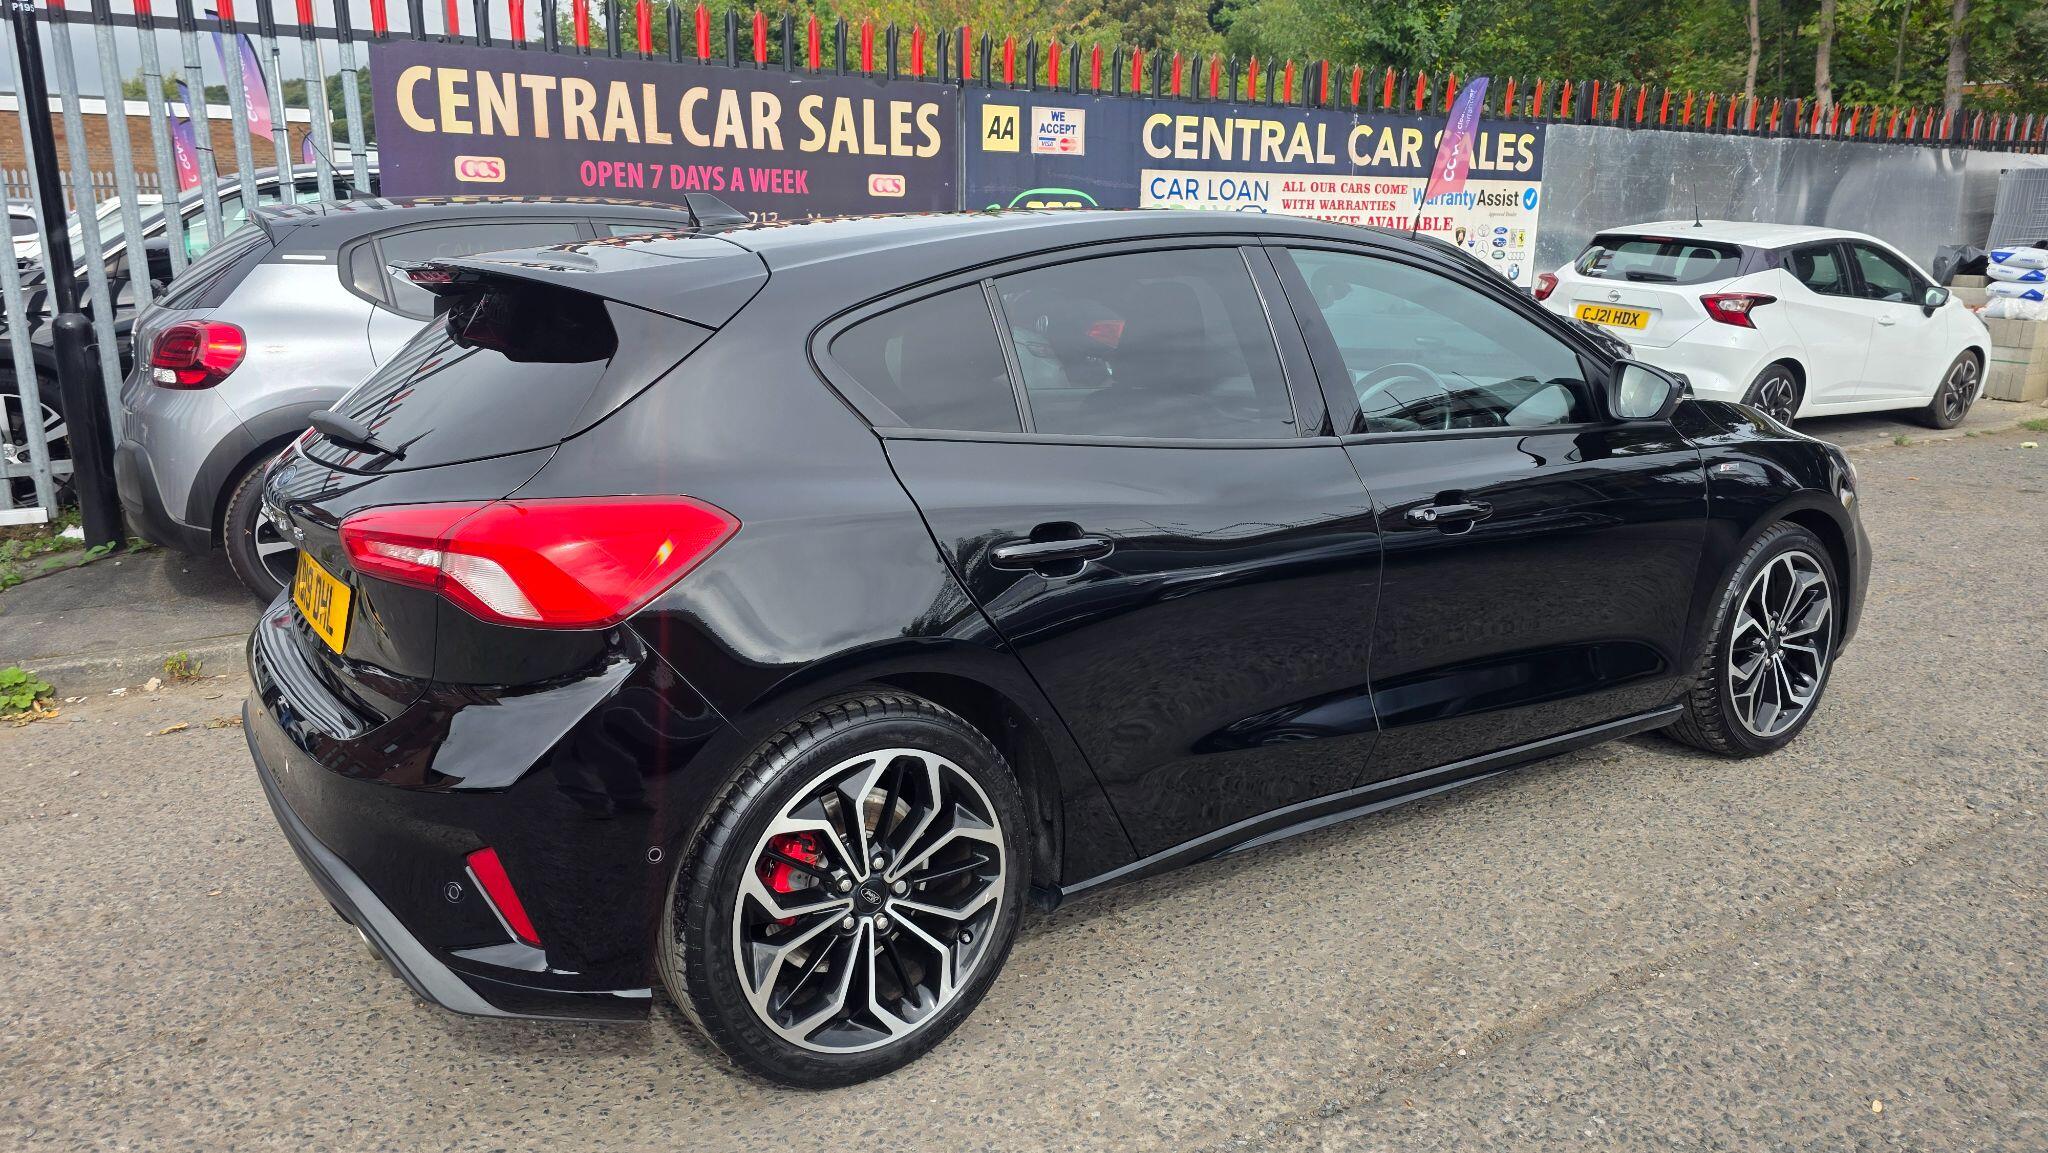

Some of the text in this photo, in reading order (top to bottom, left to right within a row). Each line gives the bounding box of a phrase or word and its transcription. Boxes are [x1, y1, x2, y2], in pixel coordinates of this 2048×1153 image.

[12, 2, 35, 12] P195
[396, 66, 942, 158] CENTRAL CAR SALES
[1050, 111, 1066, 121] WE
[987, 115, 1014, 140] AA
[1040, 123, 1077, 135] ACCEPT
[1142, 113, 1335, 164] CENTRAL
[1348, 124, 1423, 168] CAR
[580, 160, 809, 194] OPEN 7 DAYS A WEEK
[1151, 177, 1269, 201] CAR LOAN
[1282, 181, 1408, 195] ALL OUR CARS COME
[1282, 199, 1396, 211] WITH WARRANTIES
[1368, 216, 1454, 231] AVAILABLE
[1582, 308, 1640, 326] CJ21 HDX
